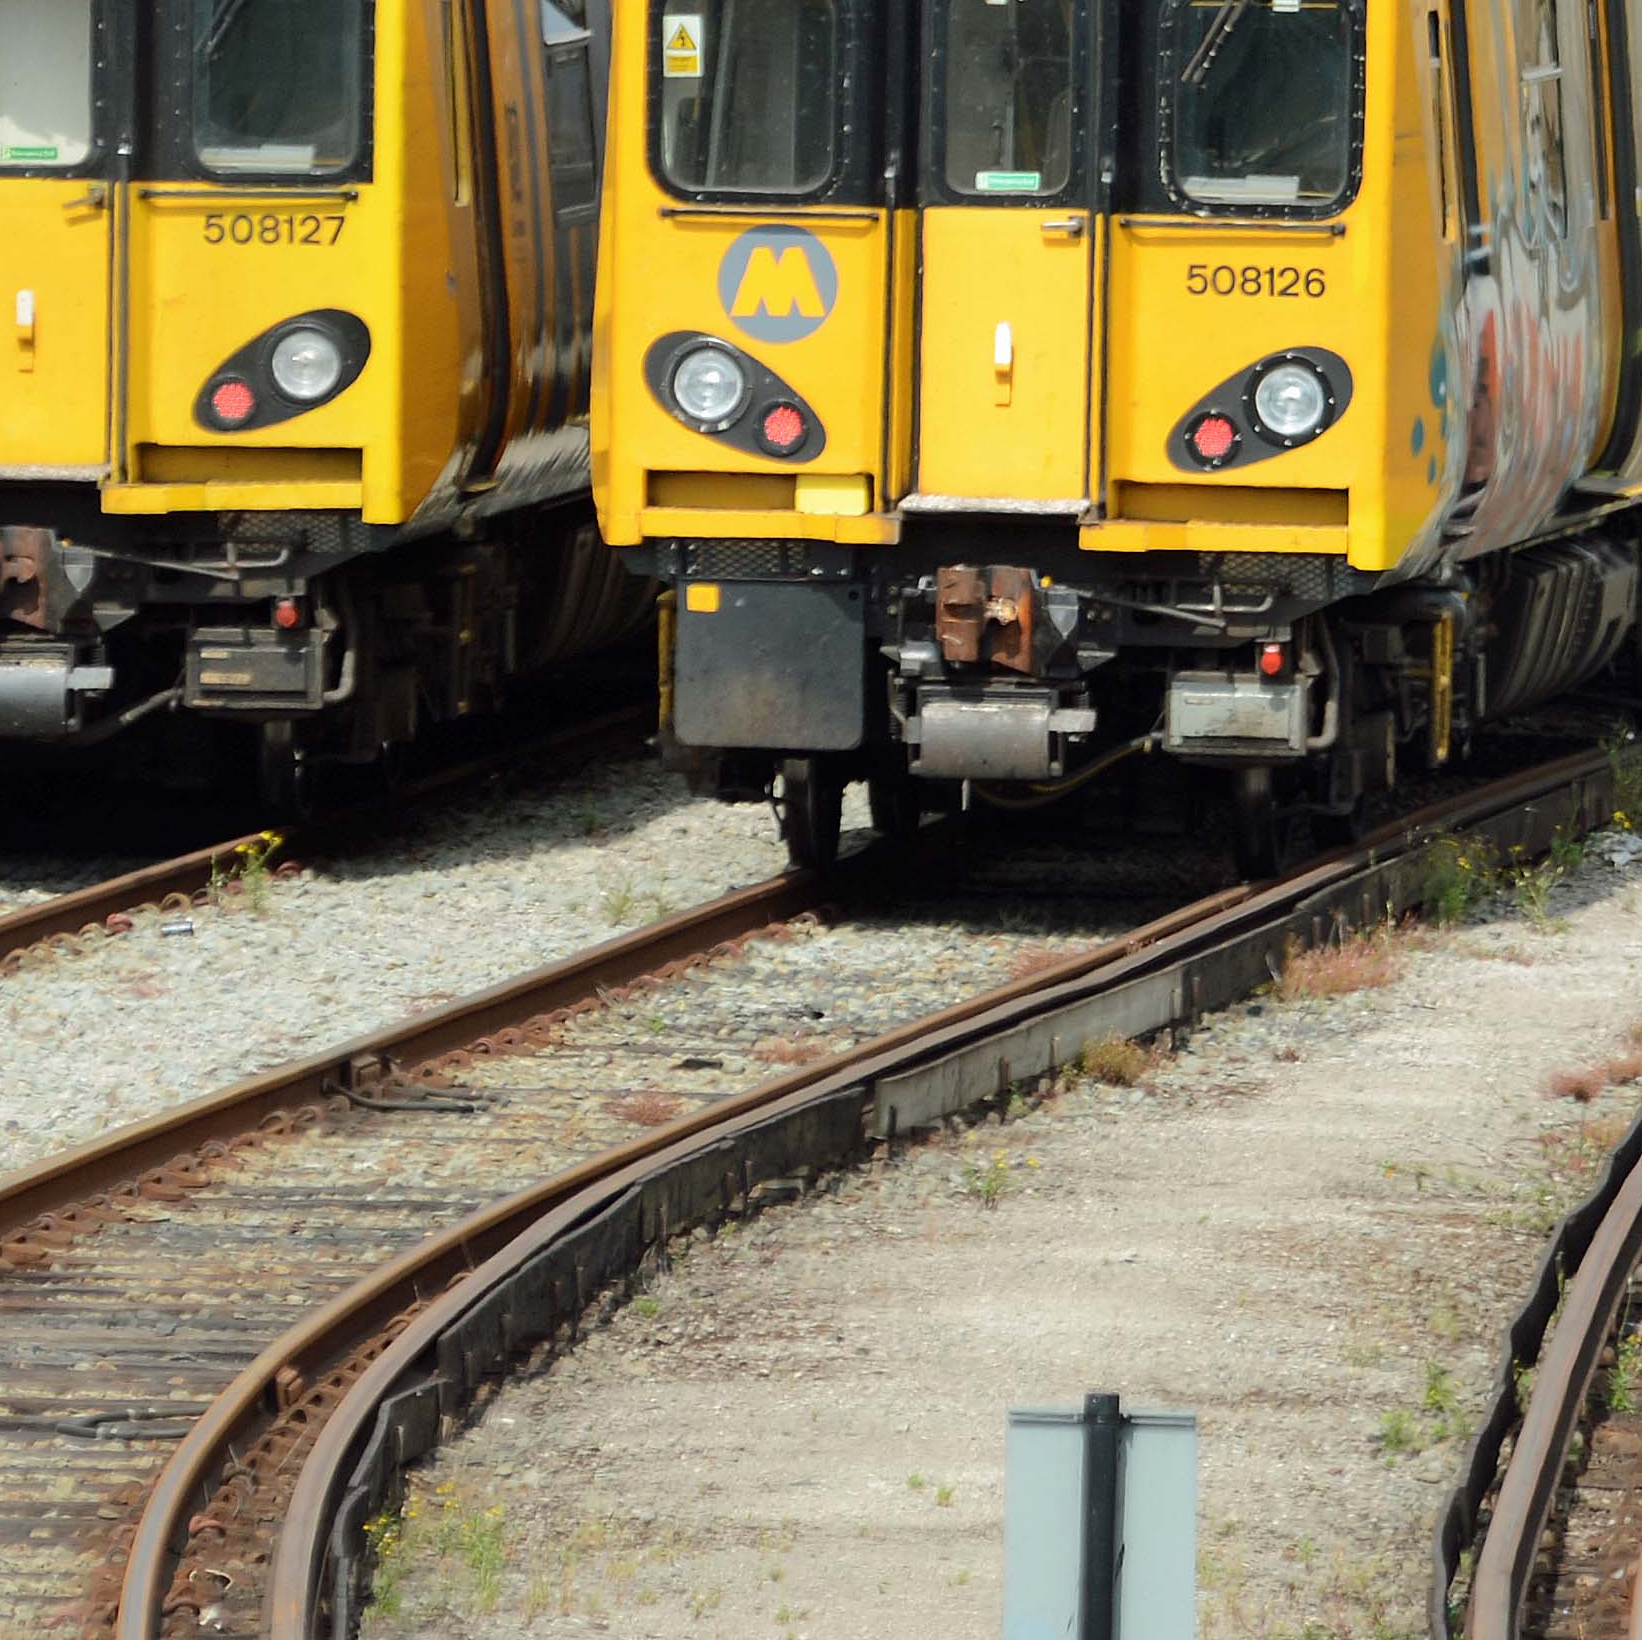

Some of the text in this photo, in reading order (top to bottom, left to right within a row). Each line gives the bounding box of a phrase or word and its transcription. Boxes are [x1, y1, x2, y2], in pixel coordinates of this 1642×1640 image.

[204, 213, 346, 246] 508127
[729, 245, 827, 318] M
[1186, 263, 1326, 299] 508126
